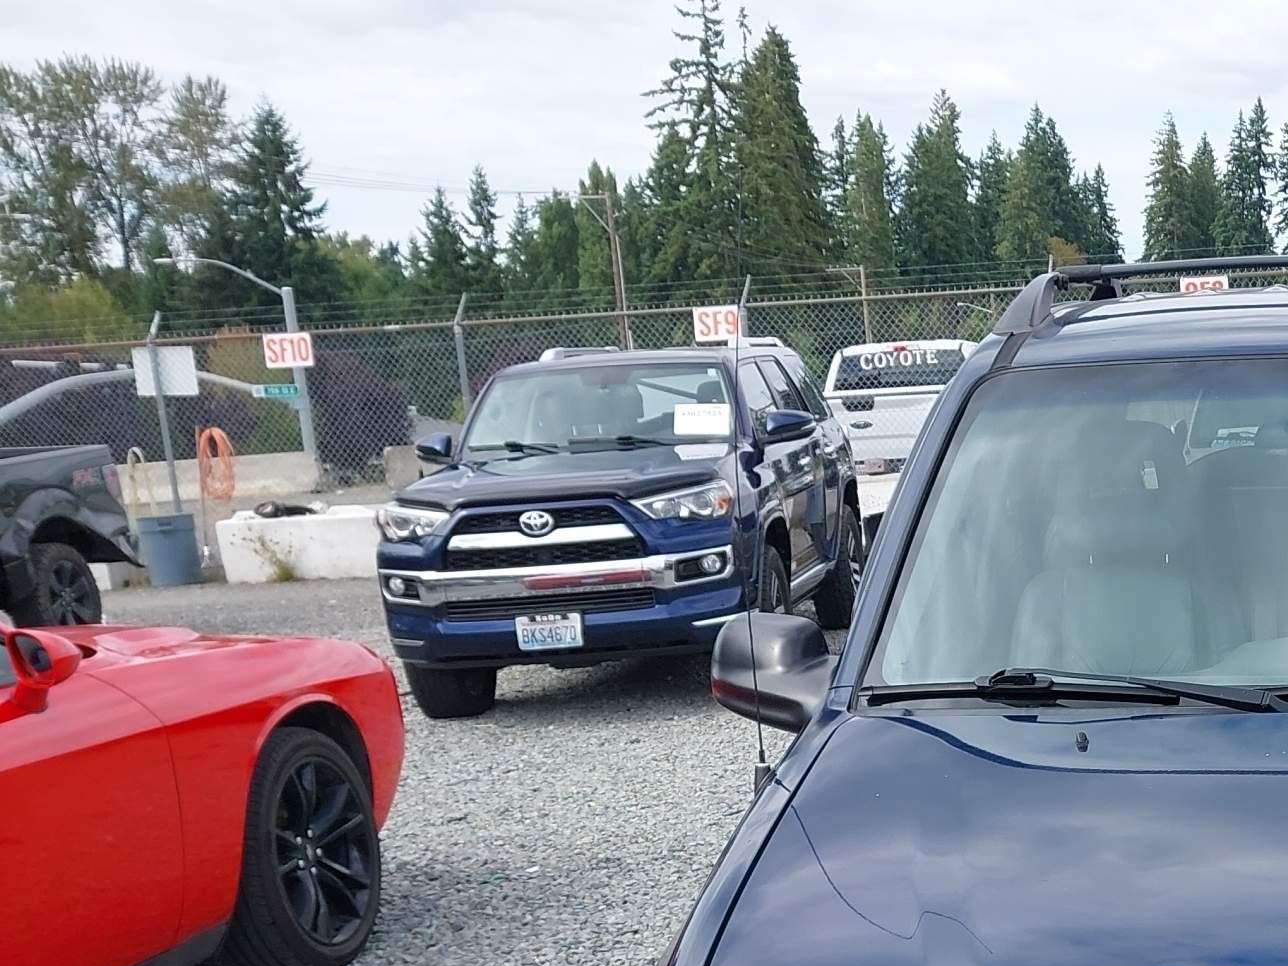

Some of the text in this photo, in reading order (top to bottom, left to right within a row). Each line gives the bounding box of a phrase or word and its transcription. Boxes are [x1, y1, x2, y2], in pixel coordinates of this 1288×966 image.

[698, 309, 738, 337] SF9
[265, 336, 310, 363] SF10
[860, 349, 939, 370] COYOTE
[521, 625, 577, 645] BKS4670
